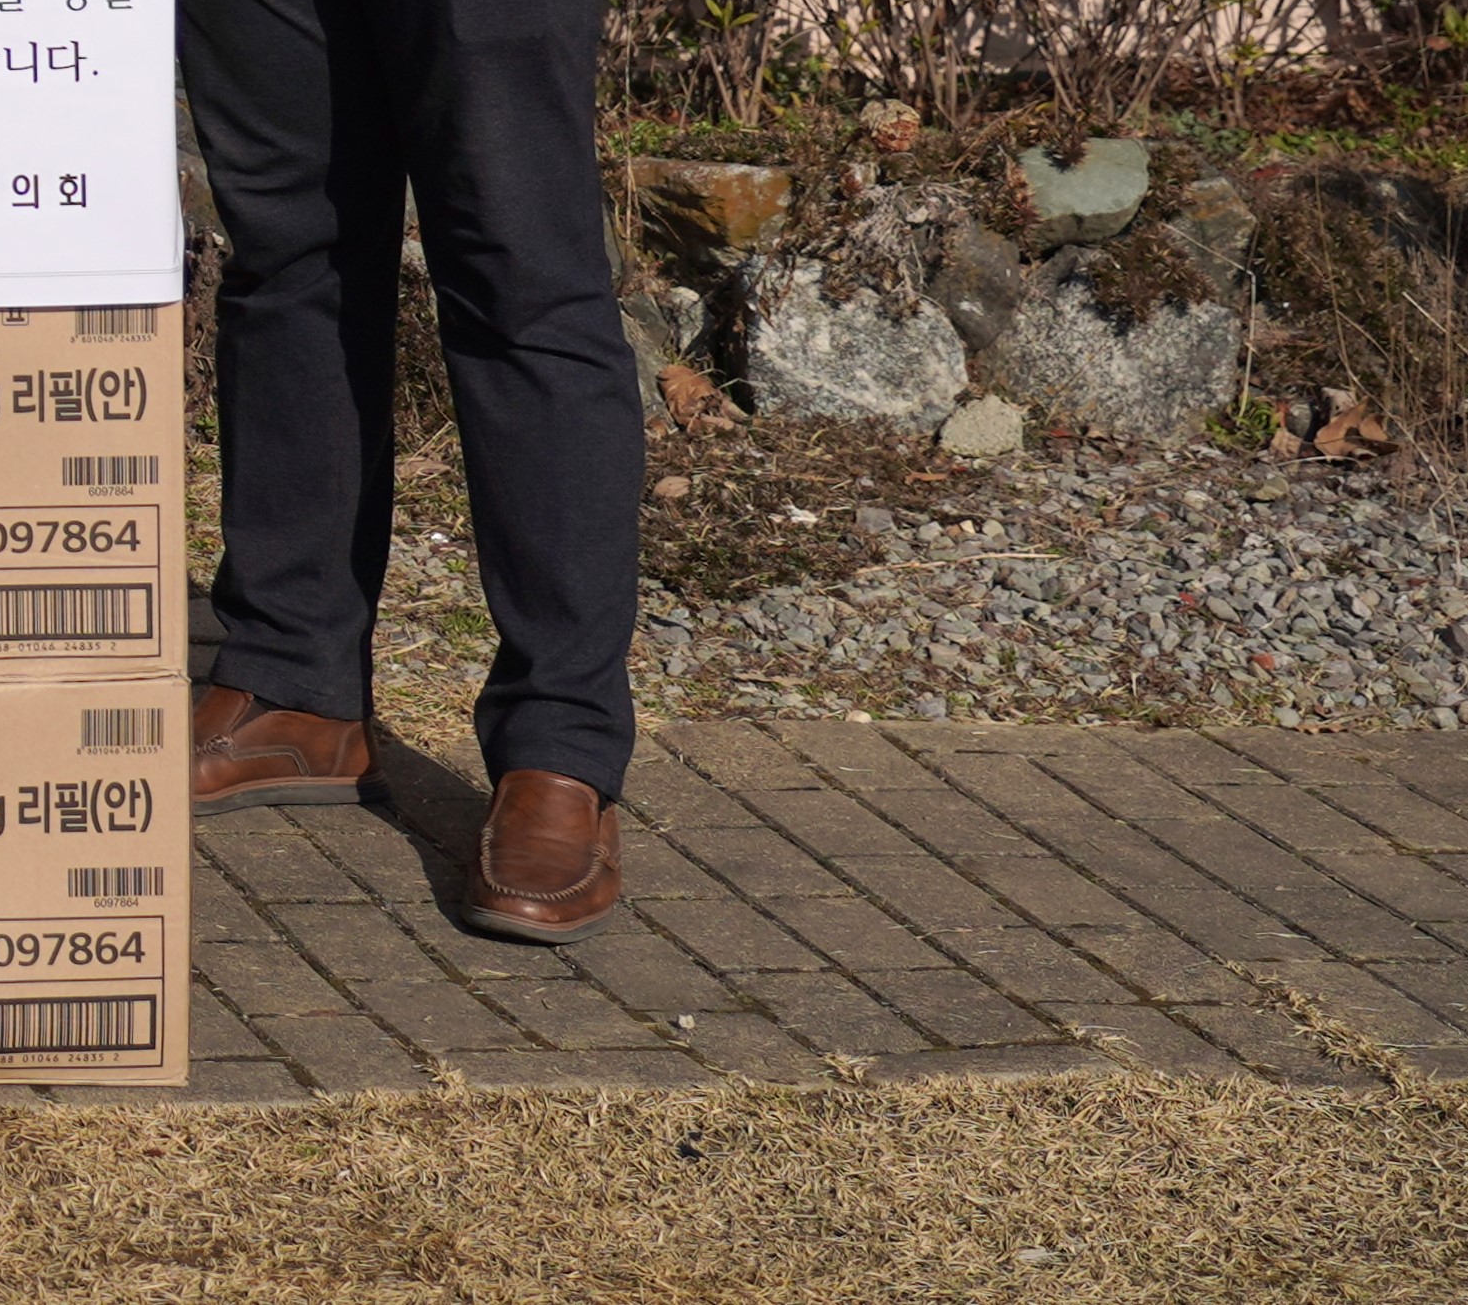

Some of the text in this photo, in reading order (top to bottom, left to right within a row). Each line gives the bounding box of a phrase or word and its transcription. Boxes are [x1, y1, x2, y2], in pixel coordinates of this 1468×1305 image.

[12, 367, 147, 423] 리필(안)
[88, 487, 135, 498] 6097864
[18, 778, 153, 834] 리필(안)
